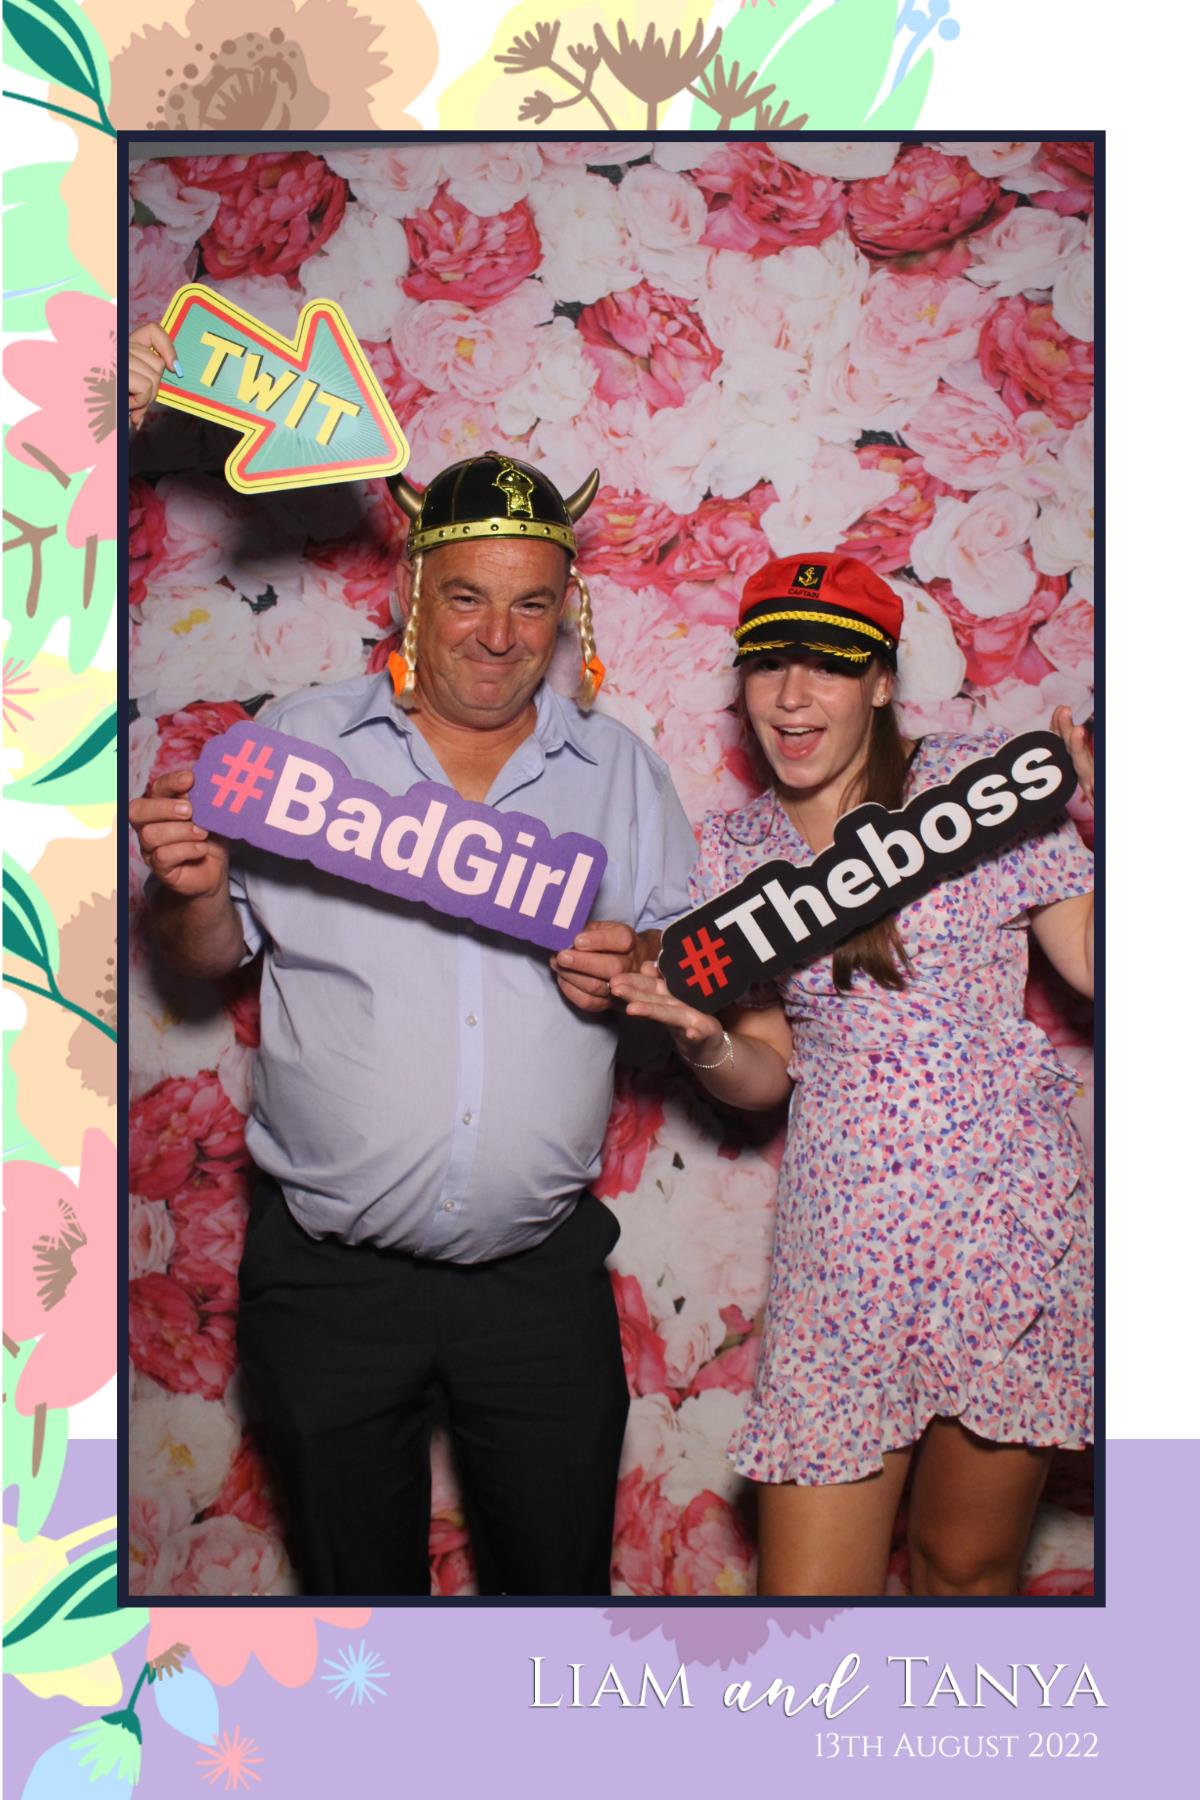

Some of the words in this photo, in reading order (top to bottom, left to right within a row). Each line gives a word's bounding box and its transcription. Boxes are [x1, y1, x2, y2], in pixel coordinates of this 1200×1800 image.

[199, 331, 362, 446] TWIT
[788, 588, 820, 598] CAPTAIN
[210, 739, 594, 930] #BadGirl
[678, 747, 1063, 997] #Theboss
